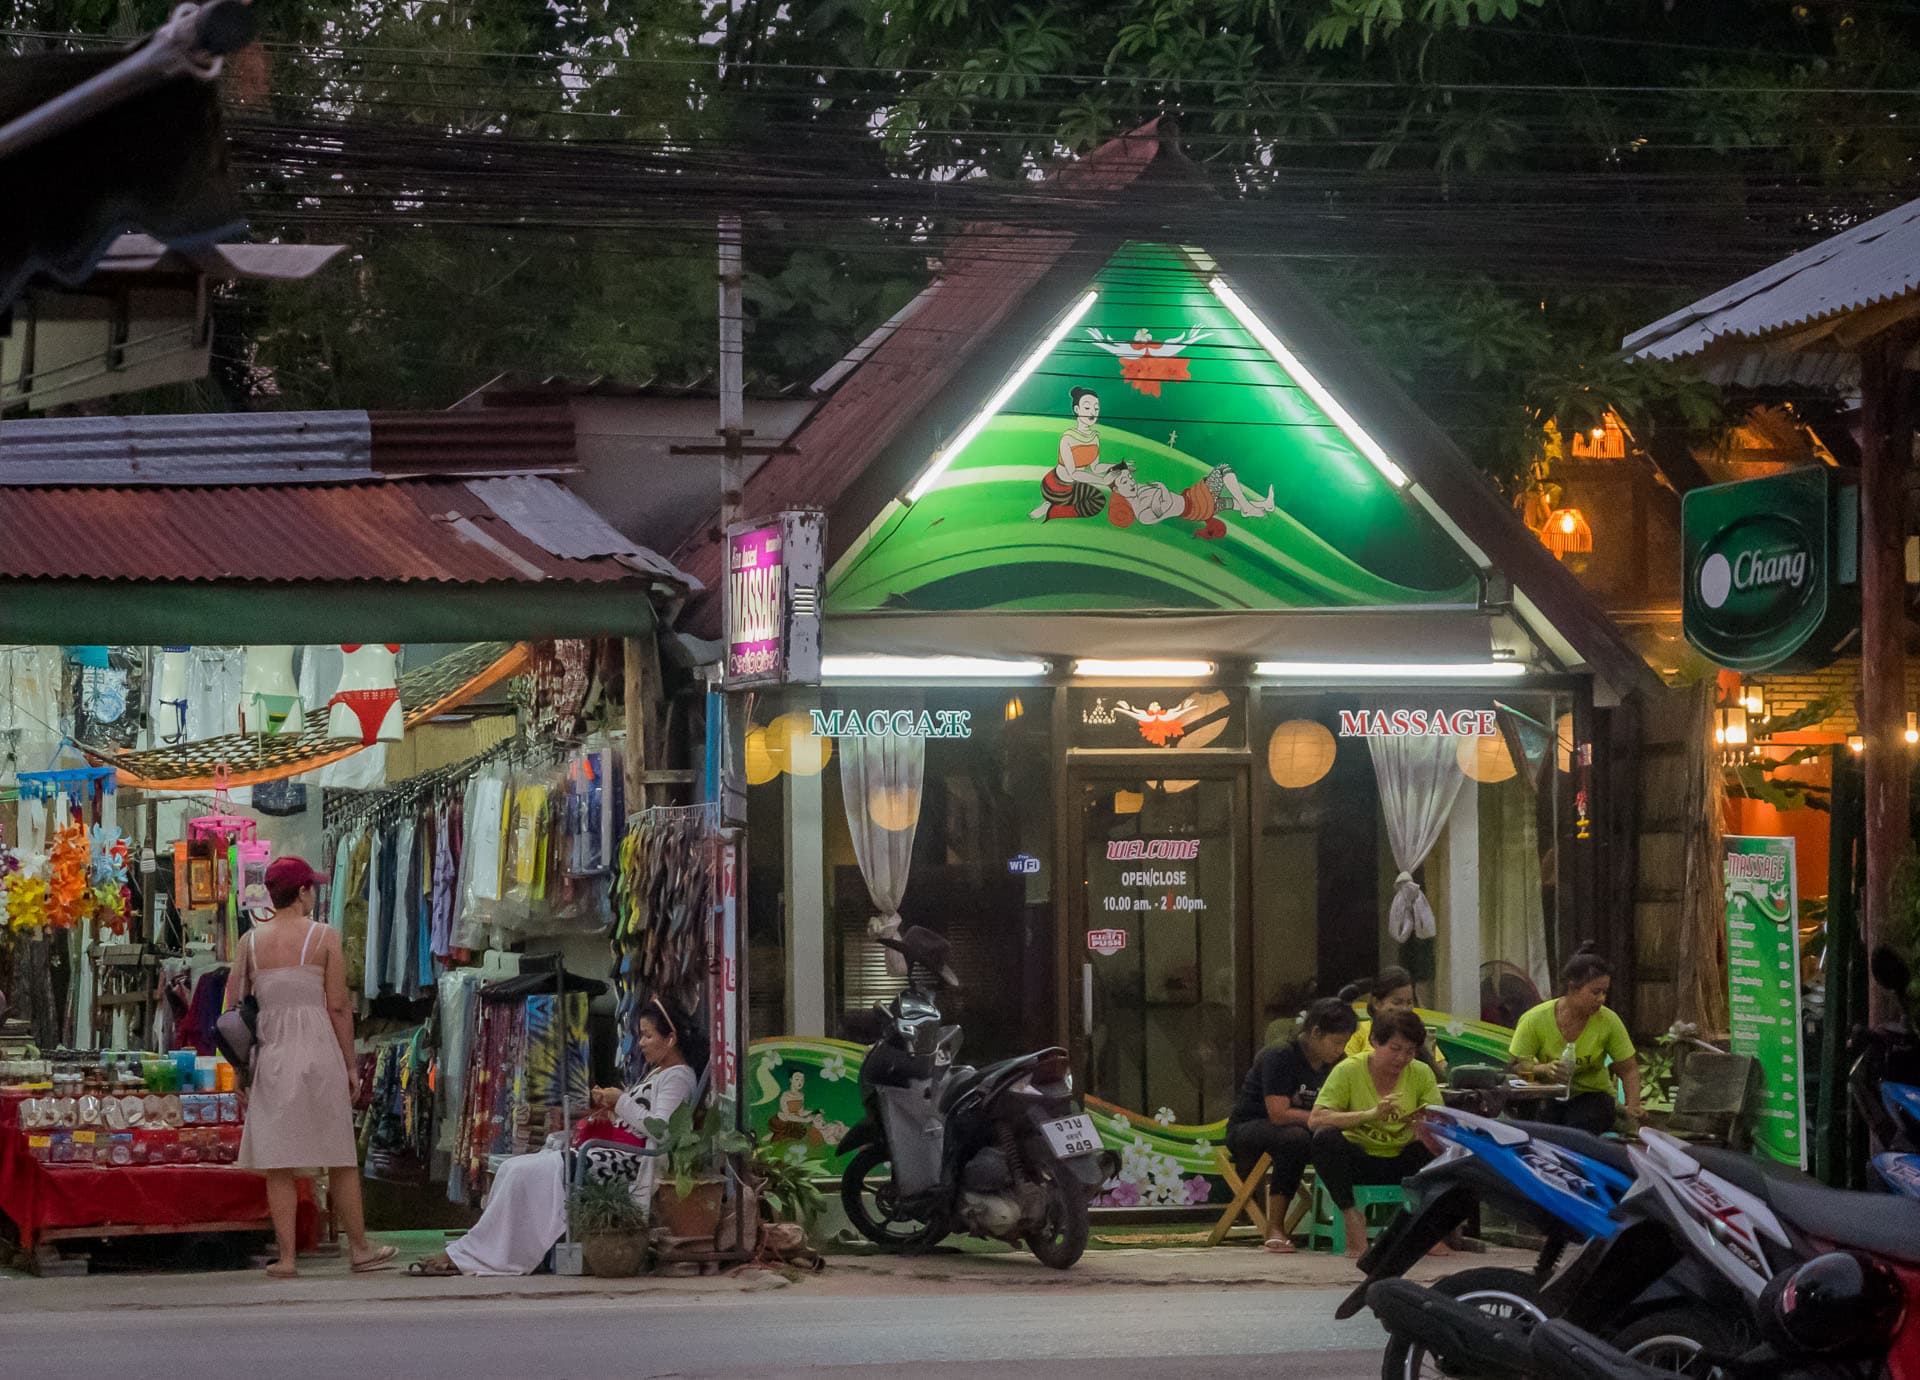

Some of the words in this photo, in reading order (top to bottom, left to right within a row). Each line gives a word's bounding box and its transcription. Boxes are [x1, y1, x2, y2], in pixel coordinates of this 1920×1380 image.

[1733, 549, 1807, 590] Chang
[731, 564, 782, 644] MASSAGE
[810, 709, 972, 738] МАССАЖ
[1338, 709, 1497, 737] MASSAGE
[1106, 839, 1200, 860] WELCOME
[1121, 868, 1187, 887] OPEN/CLOSE
[1728, 852, 1785, 884] MASSAGE
[1103, 896, 1131, 911] 10.00
[1133, 900, 1152, 911] am.
[1160, 895, 1207, 912] 2.00pm.
[1065, 1139, 1093, 1154] 949
